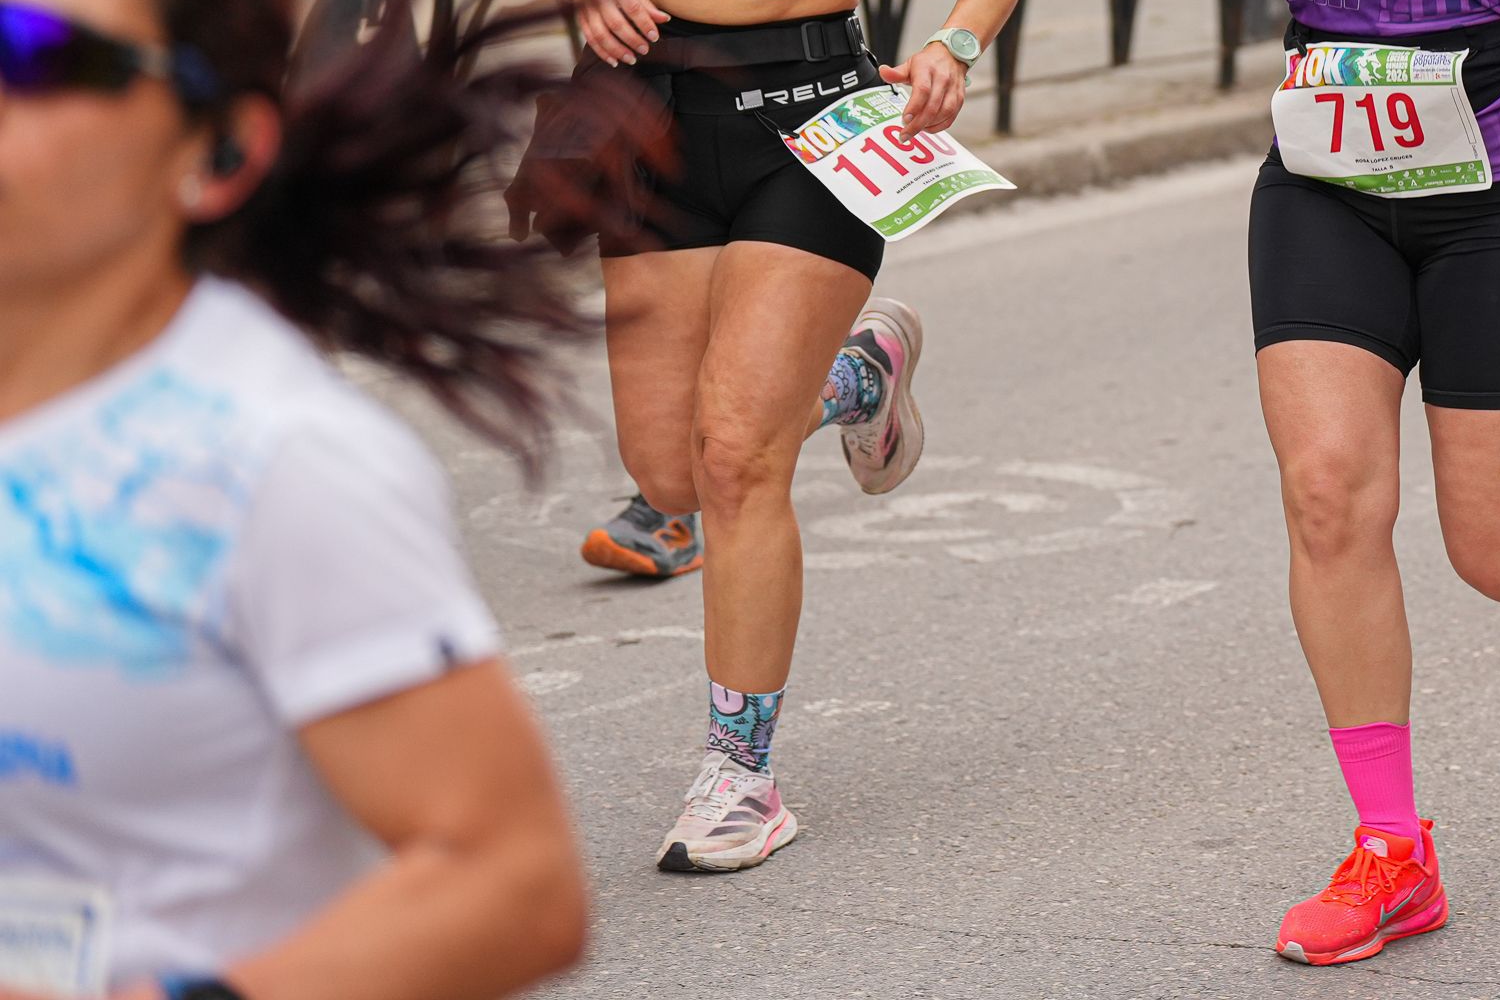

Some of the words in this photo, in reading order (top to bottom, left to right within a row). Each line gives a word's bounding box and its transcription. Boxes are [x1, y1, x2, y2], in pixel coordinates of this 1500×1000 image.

[1385, 69, 1409, 82] 2026
[1314, 92, 1426, 153] 719
[794, 114, 856, 160] 10K
[896, 180, 914, 194] MARINA
[914, 168, 936, 182] QUINTERO
[922, 177, 935, 185] TALLA
